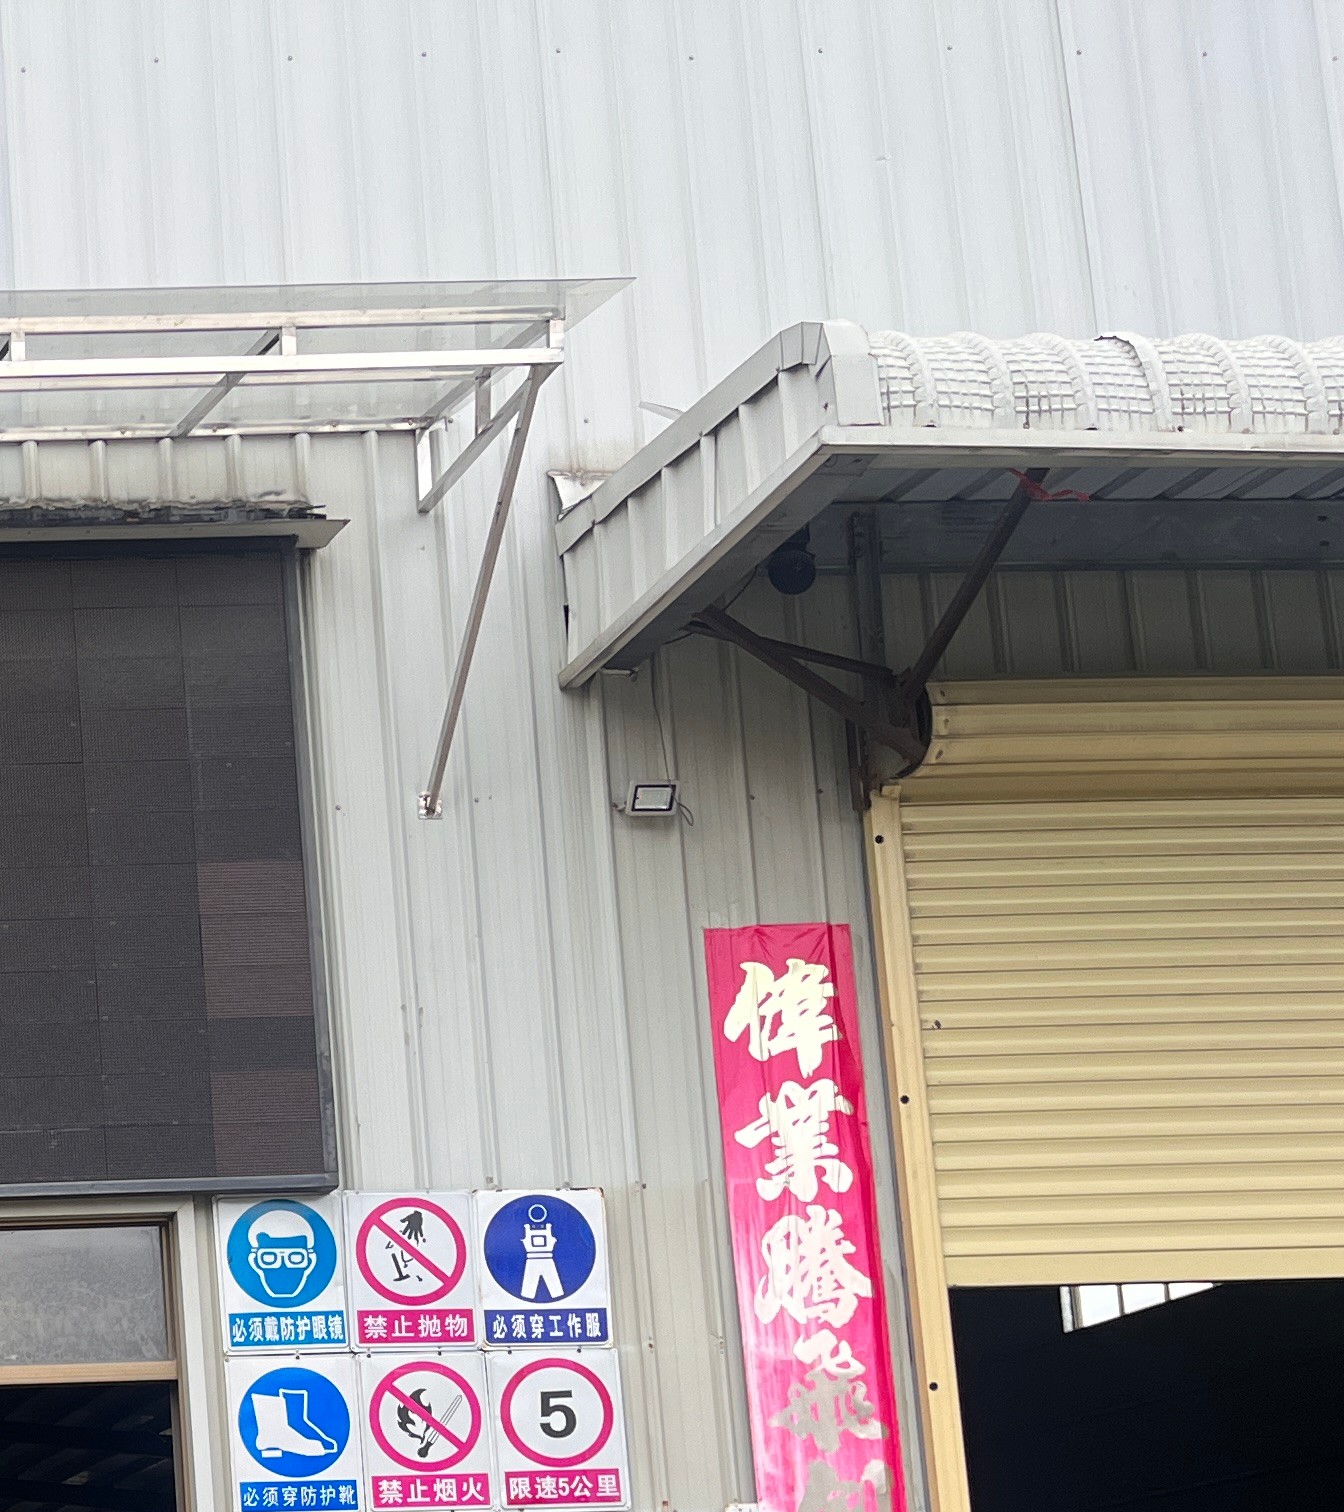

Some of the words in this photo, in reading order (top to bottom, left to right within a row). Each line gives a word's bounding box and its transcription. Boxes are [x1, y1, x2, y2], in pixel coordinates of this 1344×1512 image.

[231, 1313, 345, 1344] 必须戴防护眼镜
[362, 1314, 469, 1340] 禁止抛物
[492, 1312, 602, 1340] 必须穿工作服
[539, 1390, 578, 1438] 5
[242, 1485, 357, 1507] 必须穿防护靴
[377, 1478, 485, 1505] 禁止烟火
[508, 1473, 620, 1502] 限速5公里
